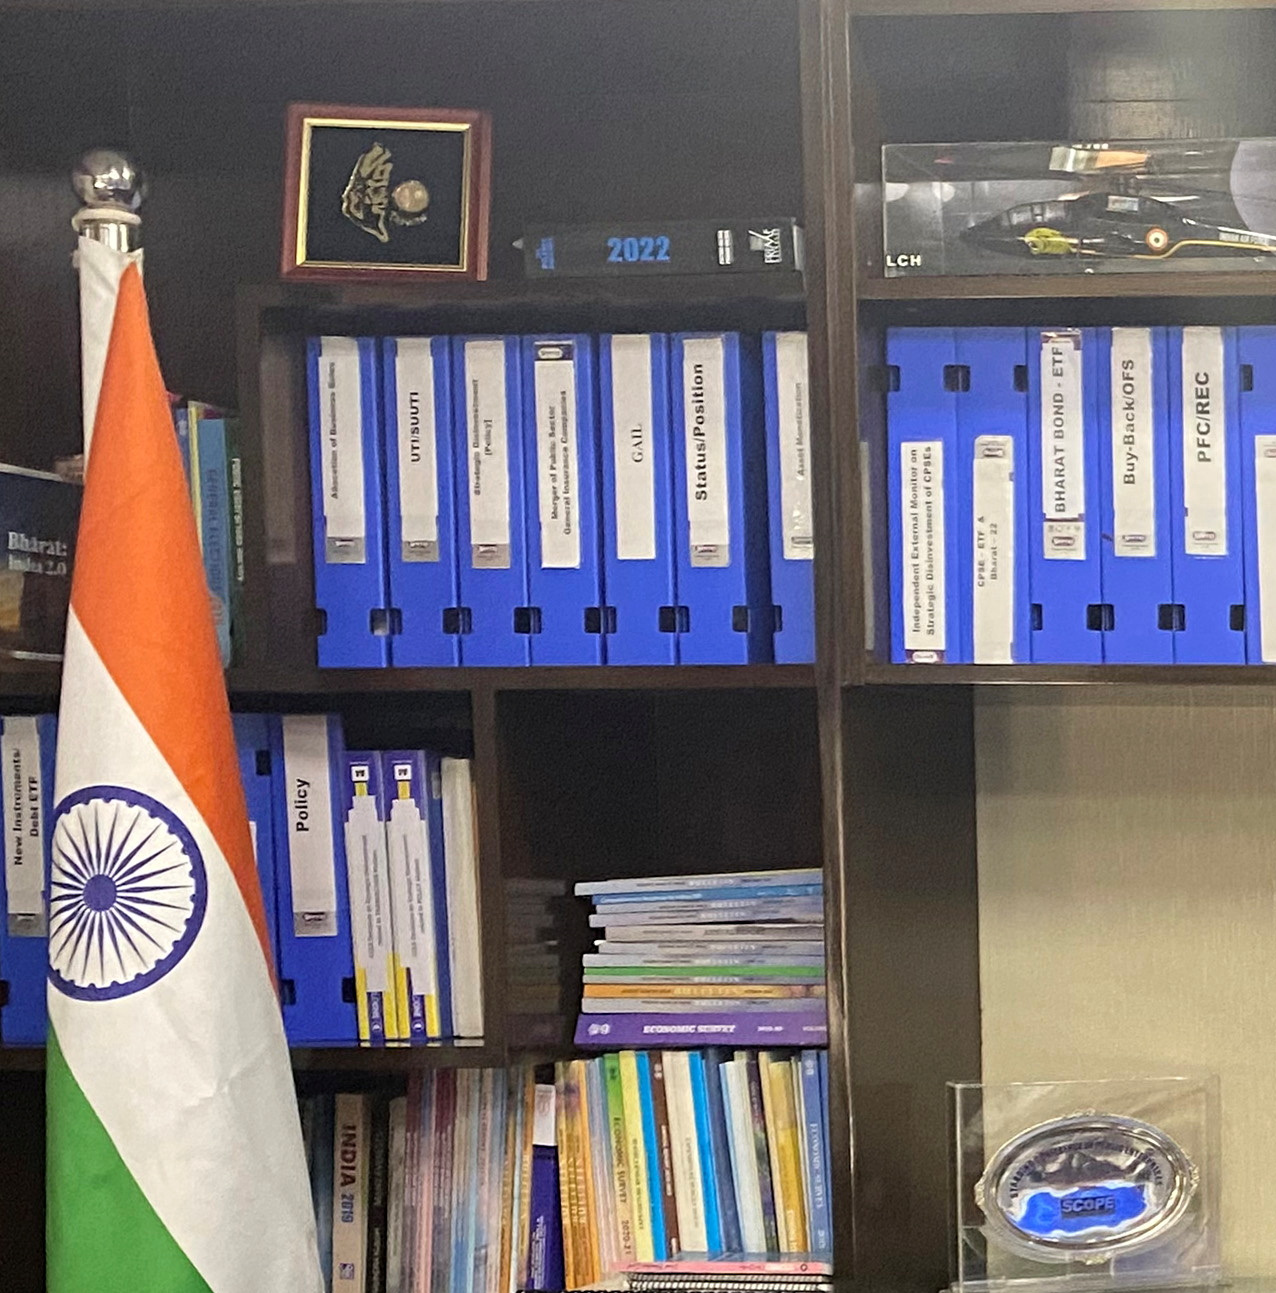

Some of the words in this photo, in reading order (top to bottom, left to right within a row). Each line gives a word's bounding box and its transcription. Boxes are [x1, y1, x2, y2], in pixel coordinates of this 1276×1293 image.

[607, 236, 670, 262] 2022
[885, 254, 922, 268] LCH
[1051, 346, 1063, 377] ETF
[409, 391, 421, 462] UTI/SUUTI
[547, 406, 556, 437] Sector
[559, 391, 569, 444] Companies
[691, 364, 708, 501] Status/Position
[1052, 392, 1065, 439] BOND
[1122, 359, 1138, 485] Buy-Back/OFS
[1195, 371, 1211, 463] PFC/REC
[548, 441, 557, 471] Public
[630, 423, 643, 463] GAIL
[910, 449, 917, 463] on
[549, 473, 558, 484] of
[561, 447, 570, 494] Insurance
[923, 446, 932, 483] CPSEs
[1053, 445, 1066, 513] BHARAT
[550, 486, 560, 519] Merger
[909, 467, 918, 509] Monitor
[923, 486, 932, 497] of
[563, 497, 572, 535] General
[990, 523, 997, 535] 22
[8, 531, 67, 556] Bharat:
[910, 512, 919, 559] External
[924, 501, 934, 580] Disinvestment
[977, 531, 985, 549] ETF
[977, 560, 985, 588] CPSE
[990, 546, 998, 580] Bharat
[911, 563, 921, 633] Independent
[925, 584, 936, 636] Strategic
[28, 776, 38, 802] ETF
[294, 778, 311, 832] Policy
[29, 807, 39, 837] Debt
[13, 836, 23, 866] New
[643, 1025, 696, 1034] ECONOMIC
[697, 1025, 737, 1034] SURVEY
[341, 1124, 357, 1187] INDIA
[613, 1117, 625, 1168] ECONOMIC
[616, 1171, 627, 1204] SURVEY
[1061, 1196, 1115, 1213] SCOPE
[341, 1192, 354, 1223] 2019
[621, 1219, 632, 1255] 2020-21
